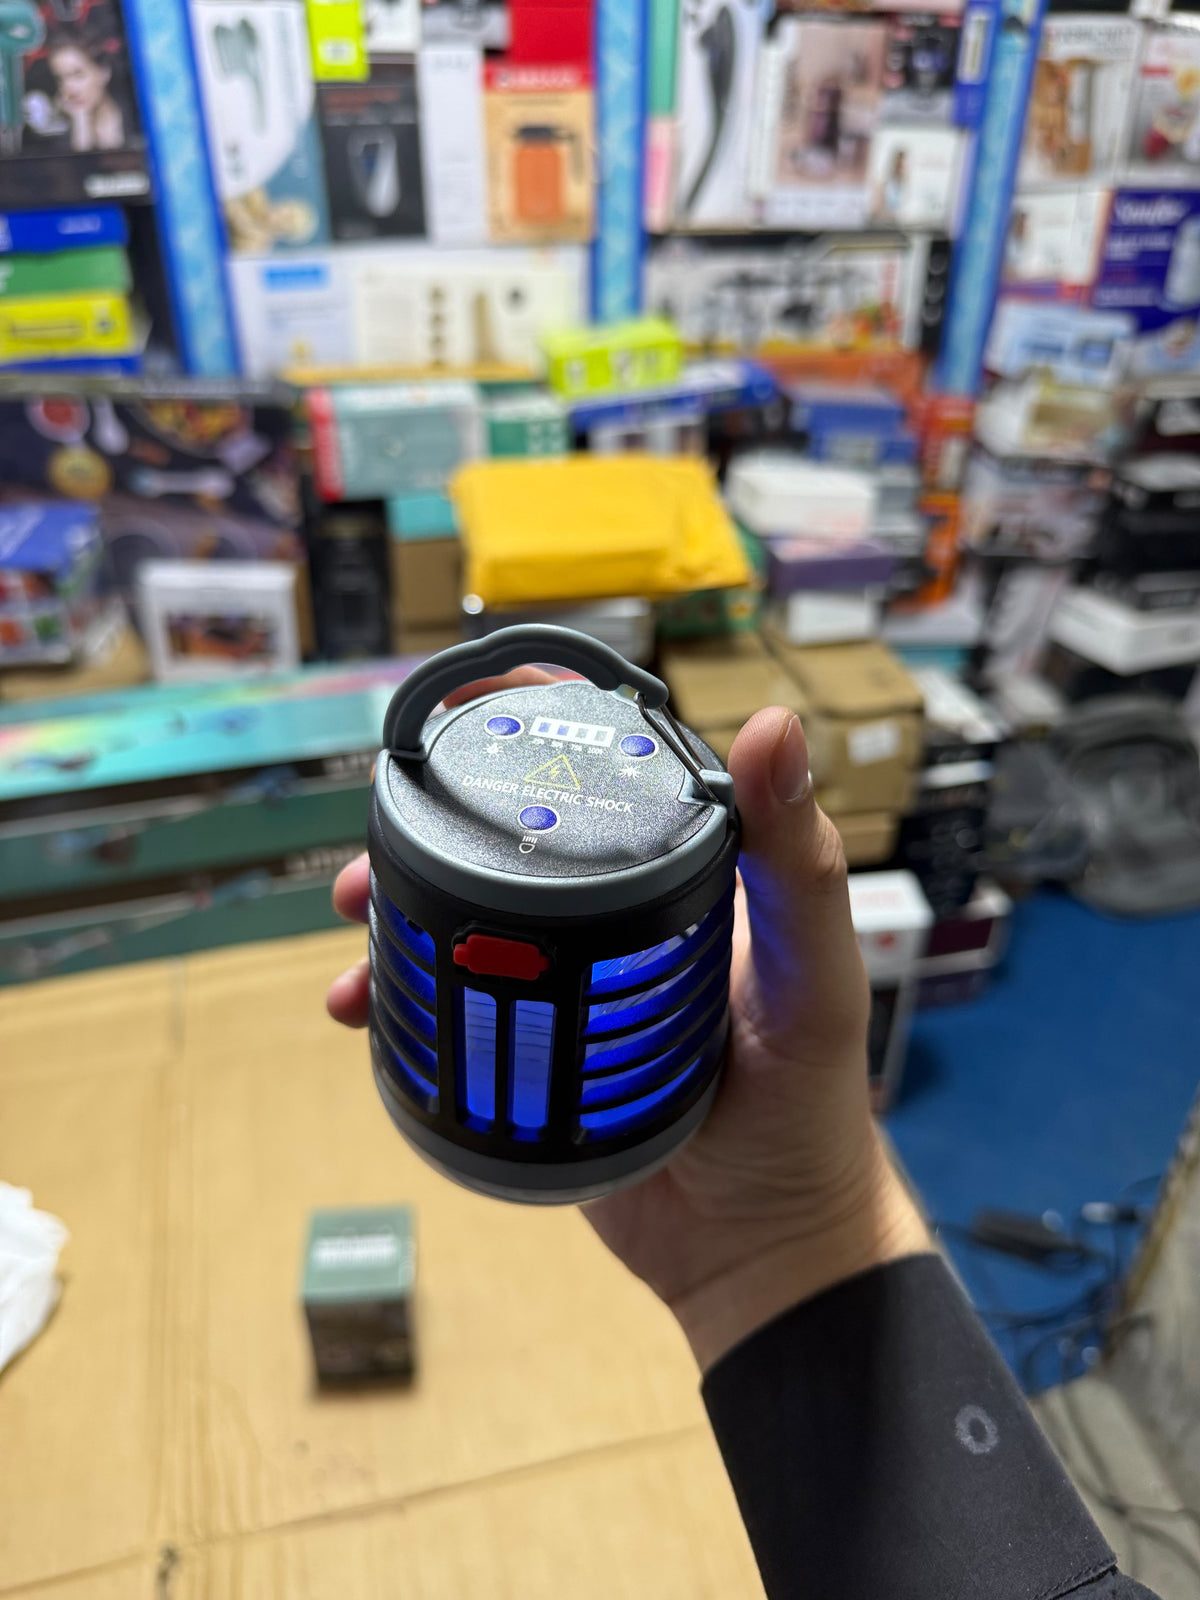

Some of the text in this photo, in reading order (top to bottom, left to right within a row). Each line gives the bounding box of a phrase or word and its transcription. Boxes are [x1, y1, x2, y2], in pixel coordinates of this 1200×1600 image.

[462, 775, 635, 813] DANGER ELECTRIC SHOCK
